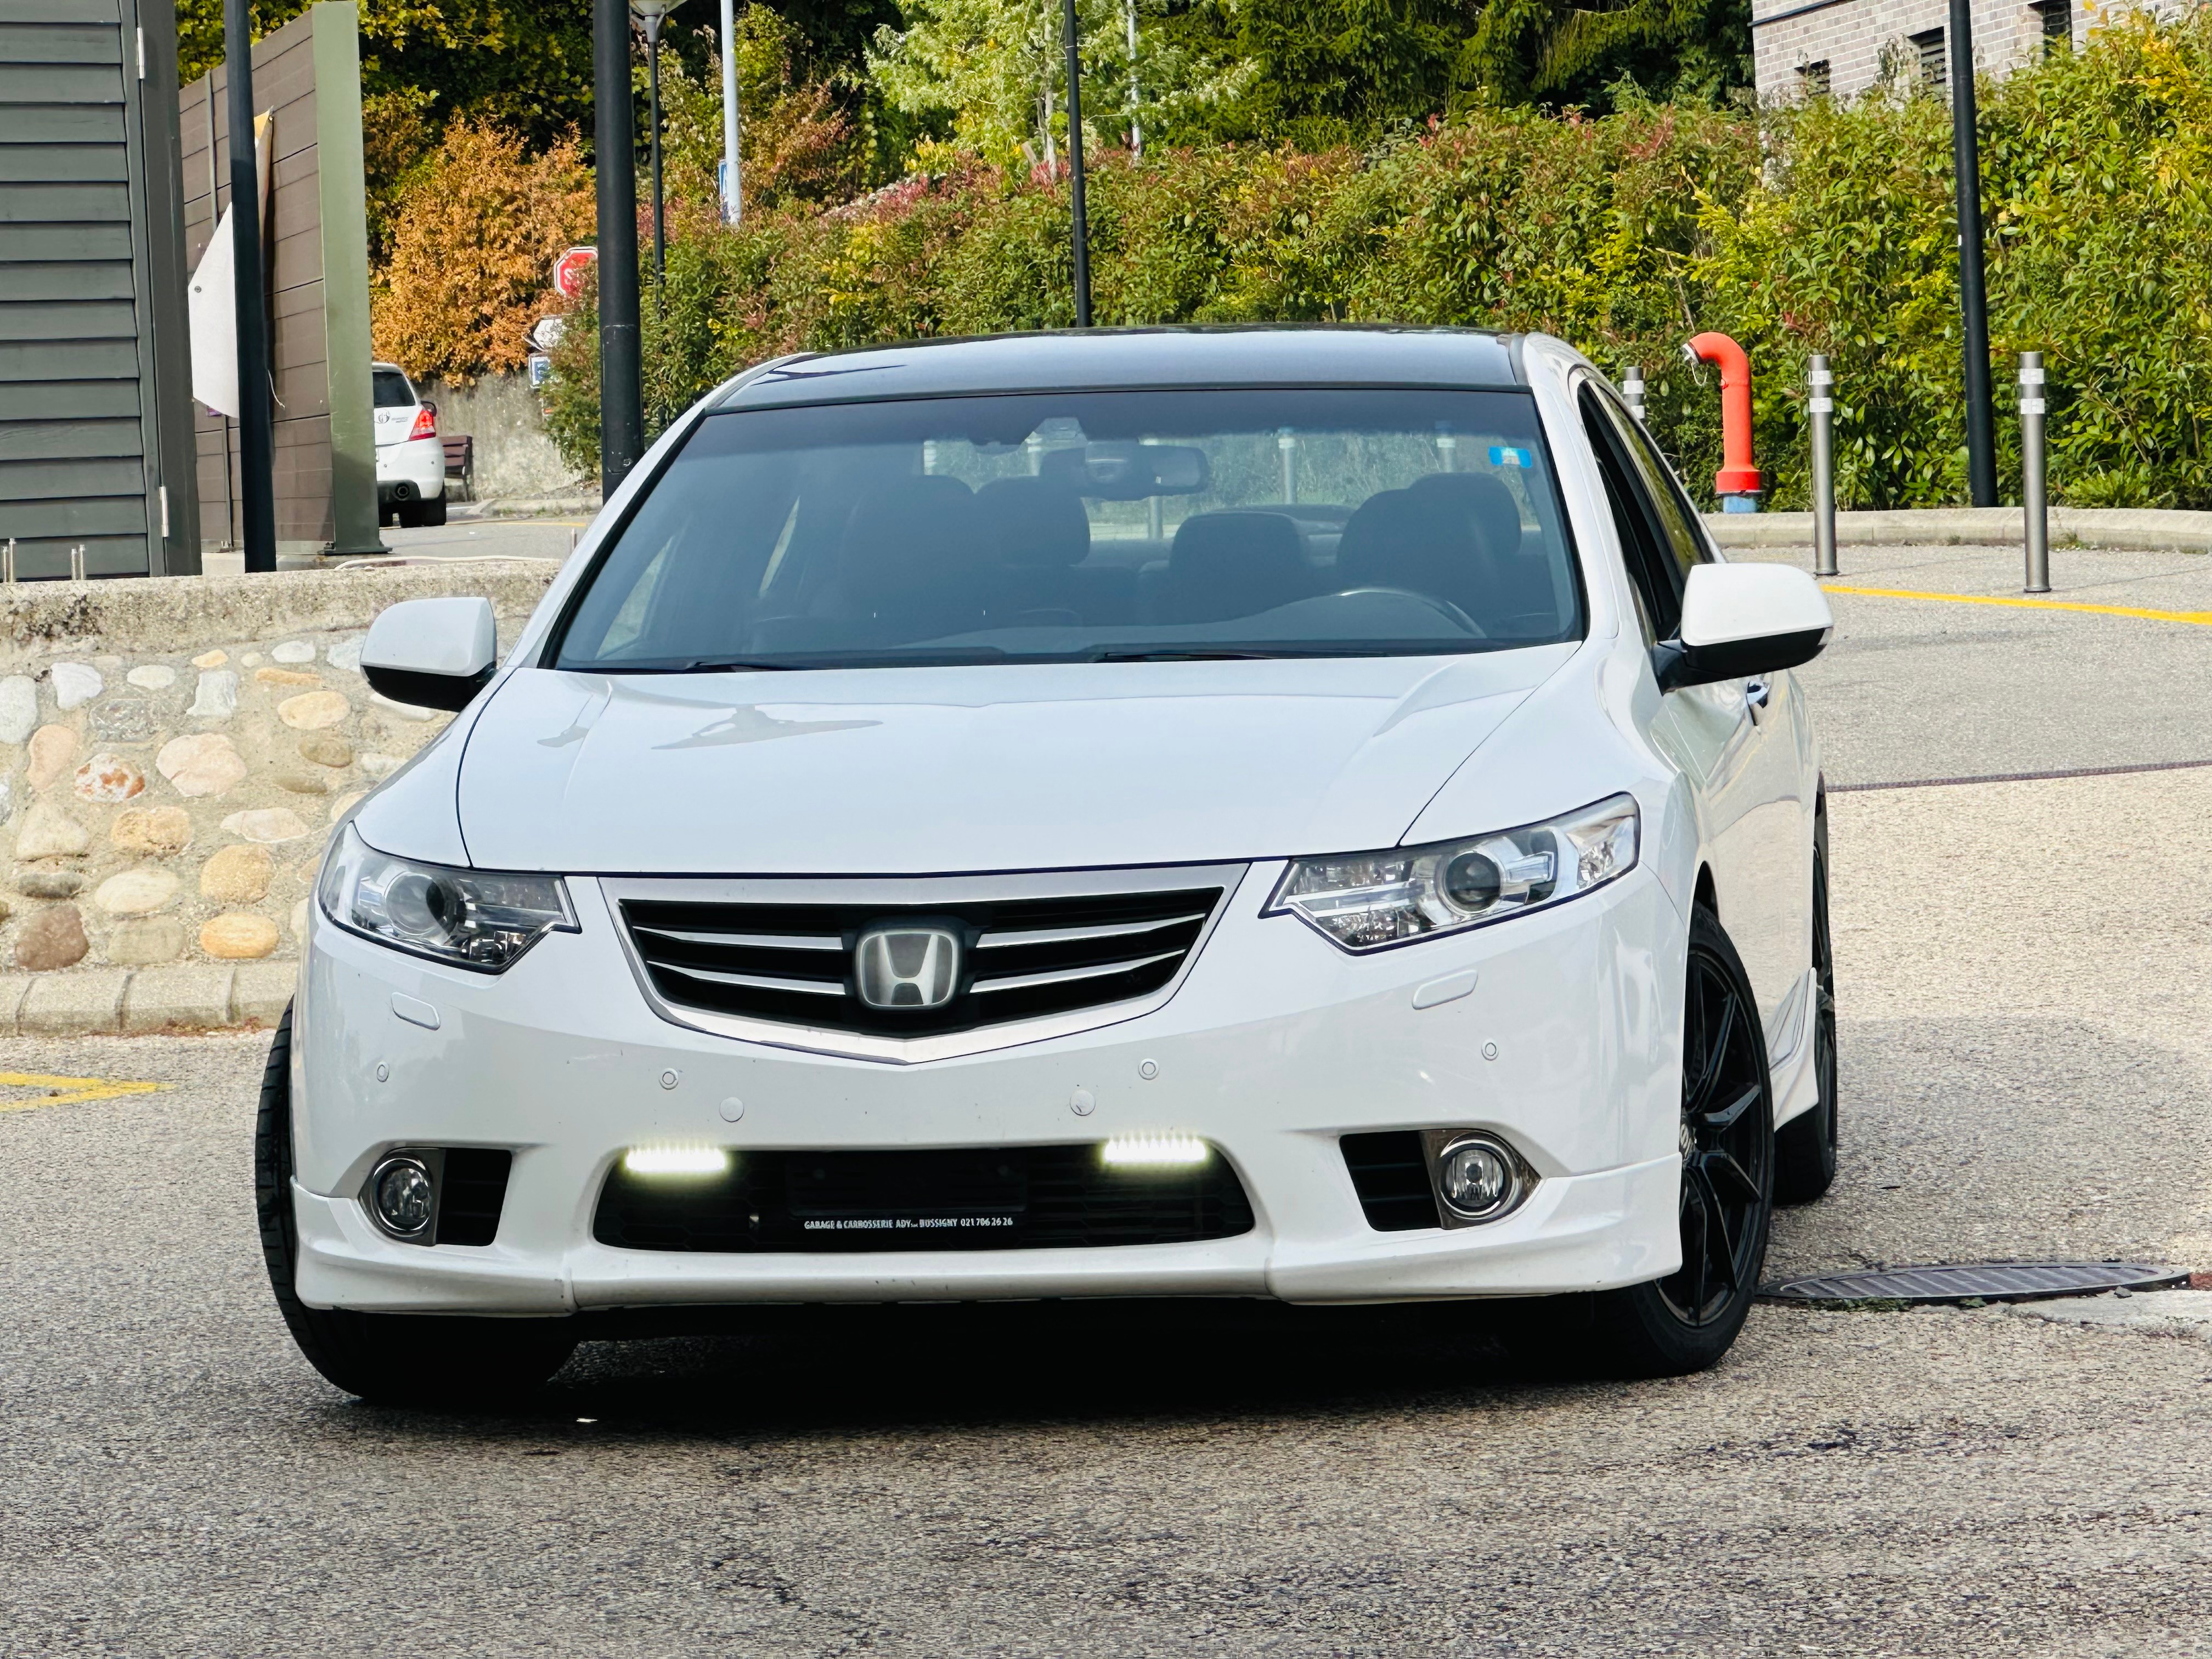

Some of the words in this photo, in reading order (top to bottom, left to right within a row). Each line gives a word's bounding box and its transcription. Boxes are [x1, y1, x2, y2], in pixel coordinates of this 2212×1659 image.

[960, 1218, 975, 1227] 021
[991, 1218, 1002, 1226] 26
[1002, 1217, 1013, 1226] 26
